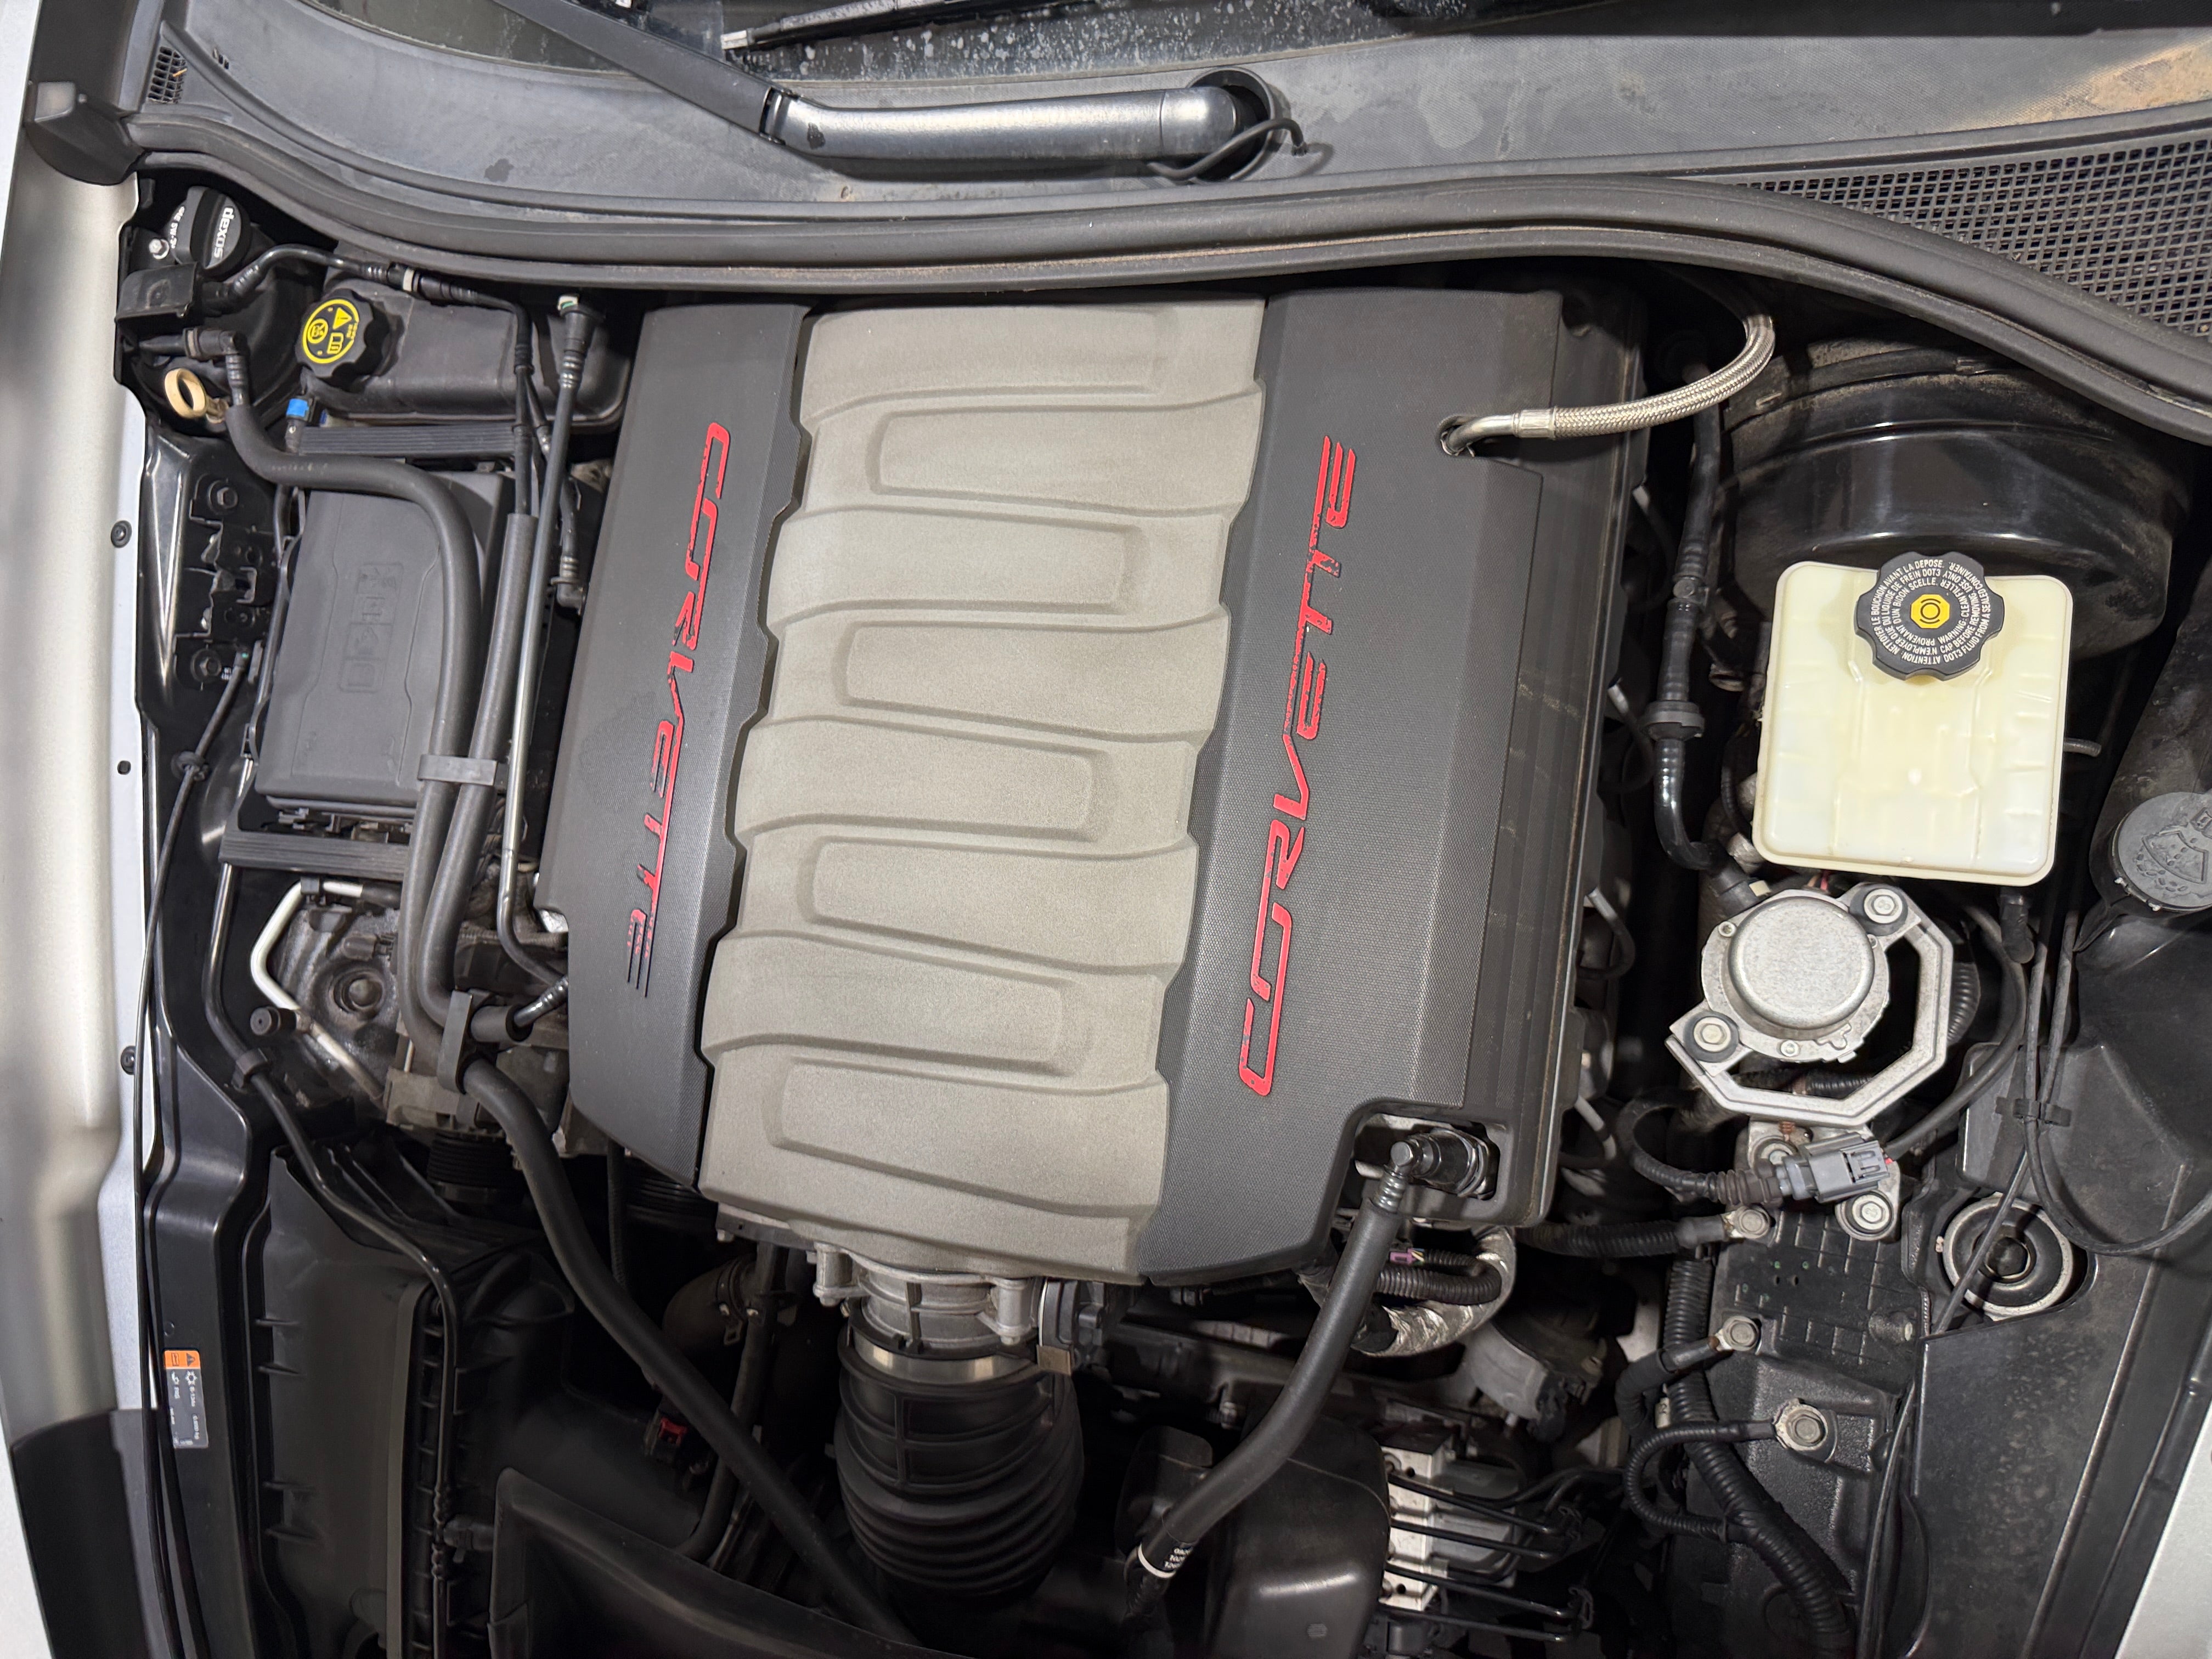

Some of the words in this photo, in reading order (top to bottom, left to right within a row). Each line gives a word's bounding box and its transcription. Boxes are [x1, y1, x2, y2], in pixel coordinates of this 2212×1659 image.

[213, 207, 235, 258] dexos
[1903, 563, 1915, 573] LA
[1914, 559, 1944, 569] DEPOSE.
[1922, 568, 1940, 577] DOT3
[1883, 568, 1903, 587] AVANT
[1899, 570, 1921, 585] FREIN
[1908, 577, 1938, 591] SCELLE.
[1942, 571, 1961, 583] ONLY
[1949, 562, 1983, 590] CONTAINER.
[1891, 582, 1903, 592] DE
[1940, 579, 1963, 597] FILLER
[1958, 579, 1973, 592] USE
[1871, 584, 1887, 615] BOUCHON
[1881, 589, 1895, 615] LIQUIDE
[1892, 587, 1910, 607] BIDON
[1978, 588, 1991, 613] SEALED
[1957, 595, 1970, 618] CLEAN
[1871, 616, 1881, 625] LE
[1881, 616, 1891, 625] DU
[1975, 618, 1990, 638] FROM
[1874, 625, 1900, 655] NETTOYER
[1885, 625, 1898, 640] QUE
[1896, 624, 1935, 646] PROVENANT
[1937, 618, 1967, 644] WARNING:
[1953, 625, 1976, 647] BEFORE
[1940, 642, 1953, 653] CAP
[1961, 636, 1980, 654] FLUID
[1900, 650, 1940, 665] ATTENTION:
[1943, 649, 1963, 663] DOT3
[627, 421, 730, 997] CORVETTE
[1238, 435, 1356, 1097] CORVETTE
